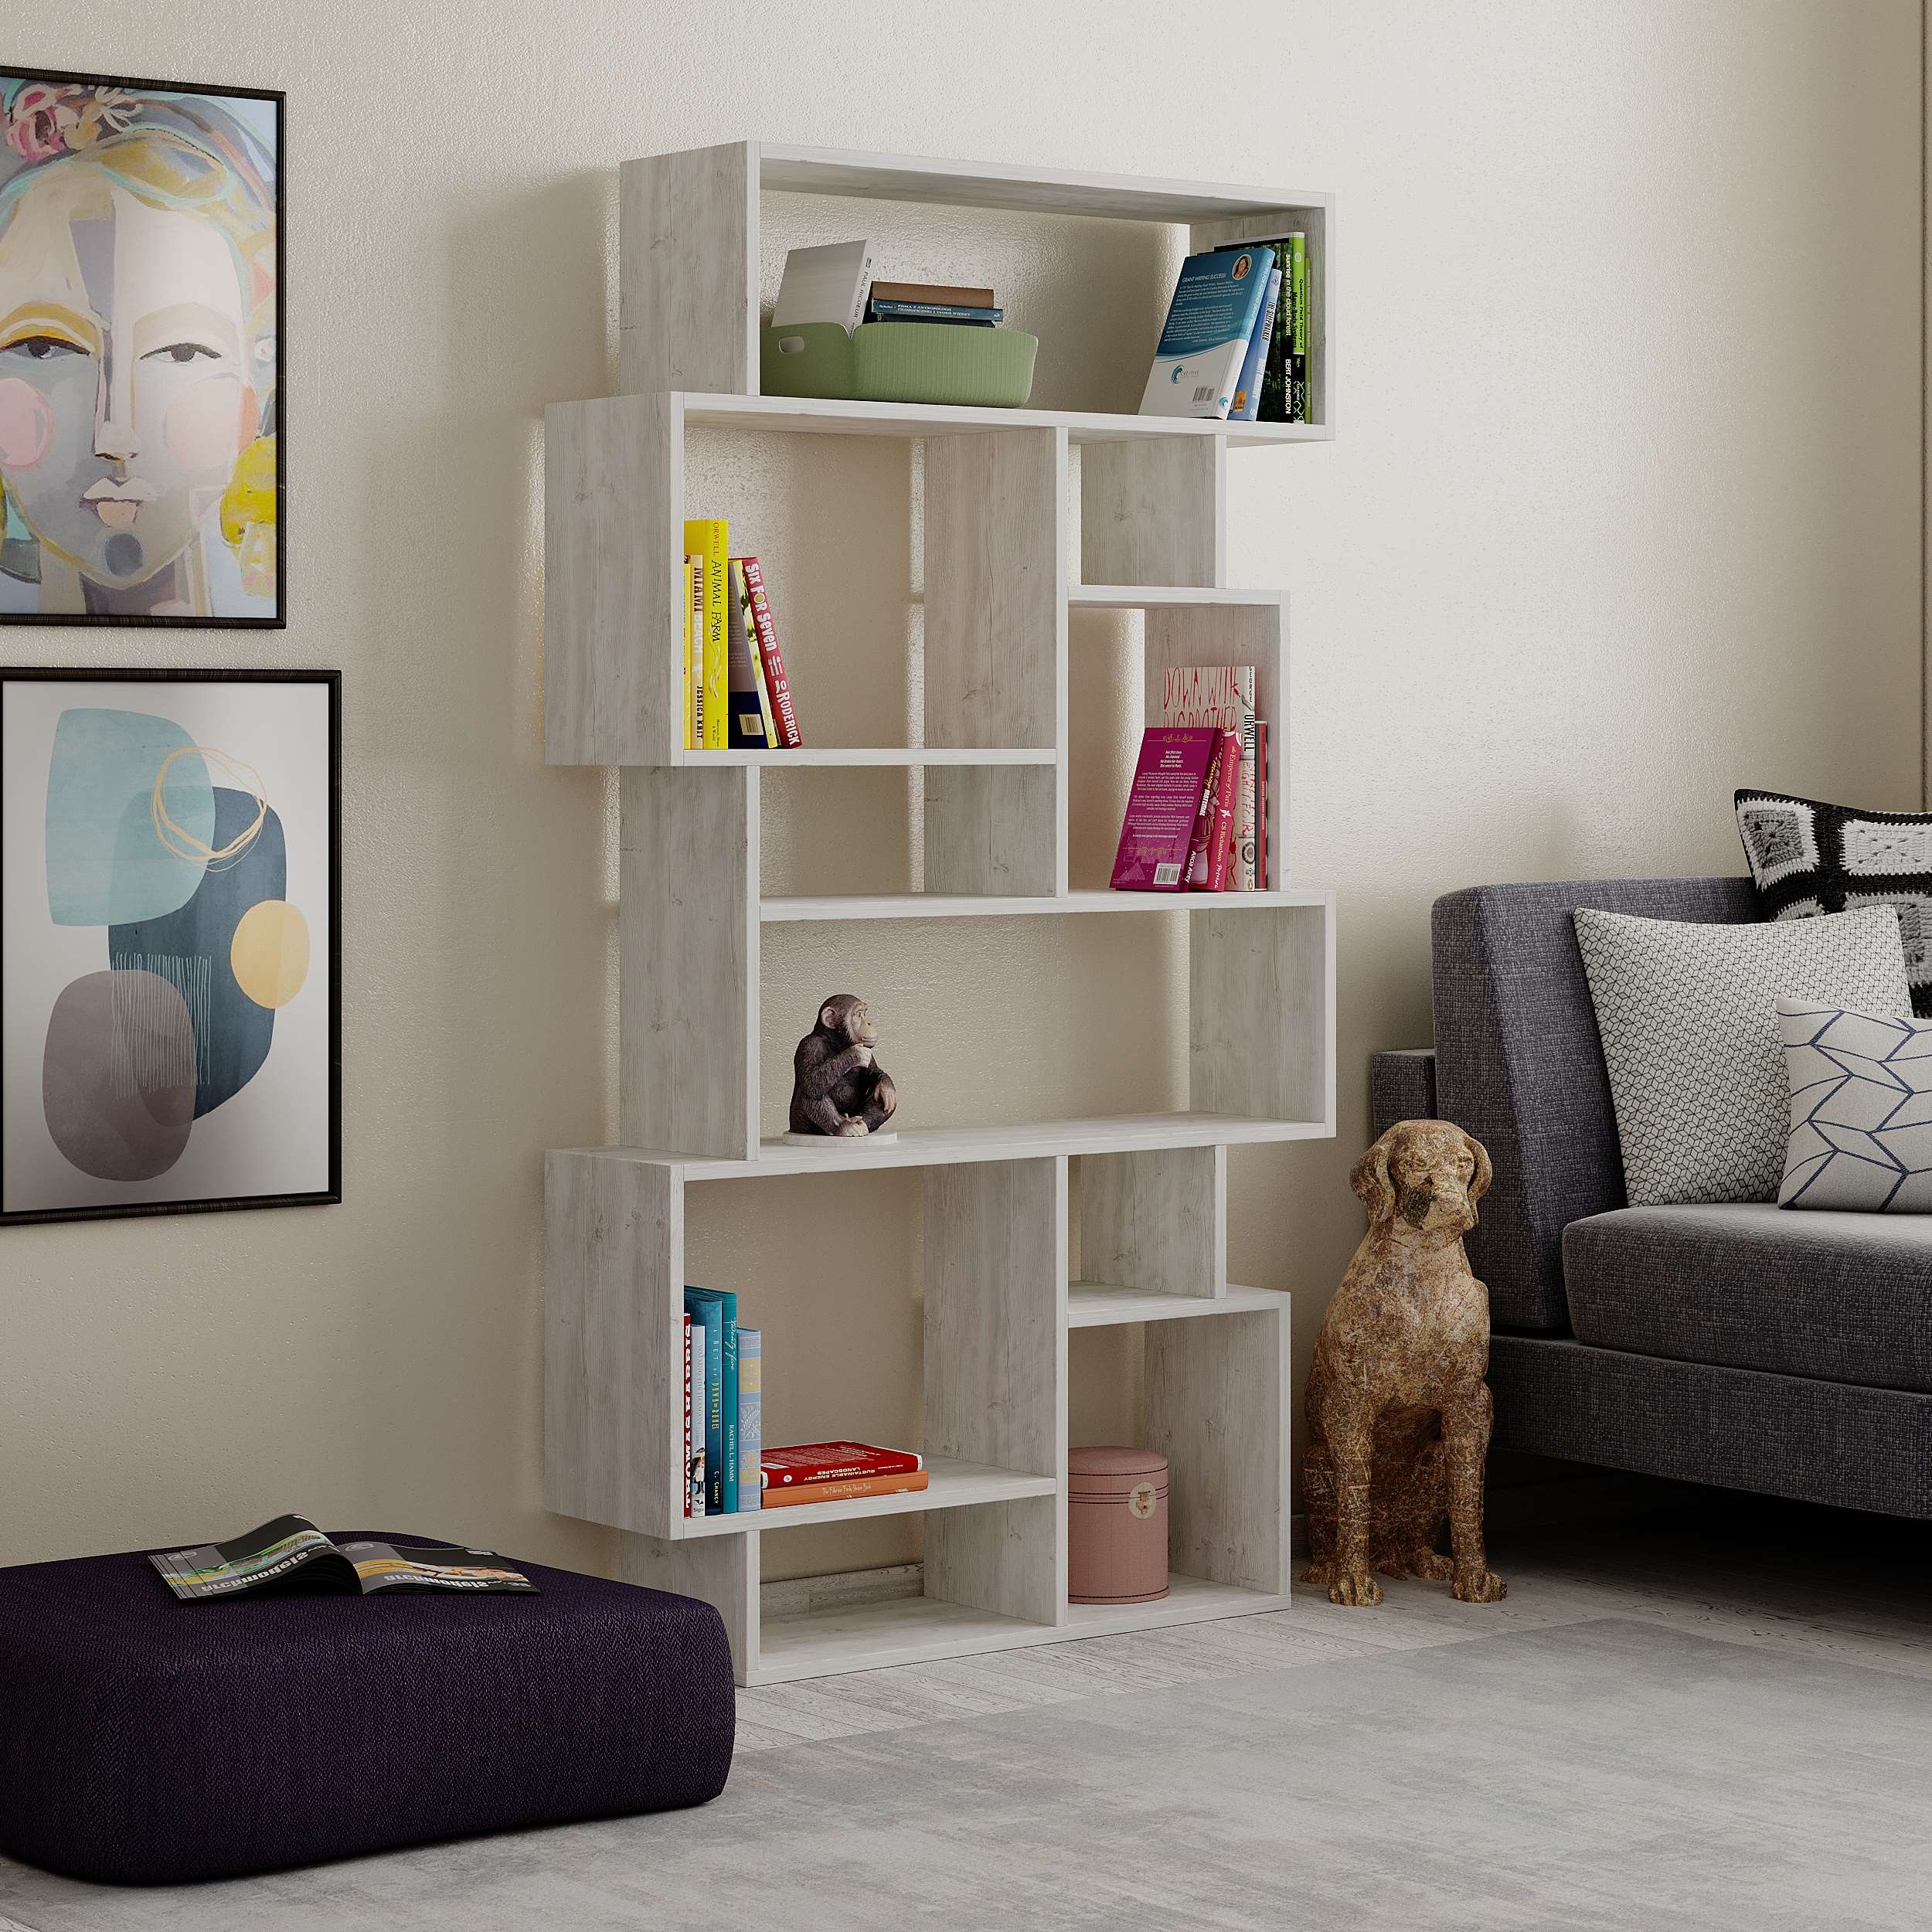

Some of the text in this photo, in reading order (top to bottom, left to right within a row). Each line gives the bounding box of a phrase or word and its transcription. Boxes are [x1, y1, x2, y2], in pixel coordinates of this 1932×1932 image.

[853, 271, 869, 318] PAUL RICOEUR
[1261, 310, 1274, 342] SLEEPWALKER
[711, 560, 722, 607] ANIMAL
[750, 585, 767, 611] FOR
[694, 567, 703, 653] MIAMI BEACH
[711, 611, 723, 642] FARM
[1163, 666, 1240, 709] DOWN WITH
[776, 692, 800, 746] RODERICK
[1243, 714, 1255, 752] ORWELL
[1226, 752, 1236, 781] Emperor
[1223, 786, 1233, 808] Paris
[1217, 821, 1227, 862] CS Richardson
[1184, 851, 1196, 883] Alicia Airey
[711, 1409, 719, 1430] BONES
[817, 1467, 860, 1476] LANDSCAPES
[832, 1469, 876, 1478] SUSTAINABLE
